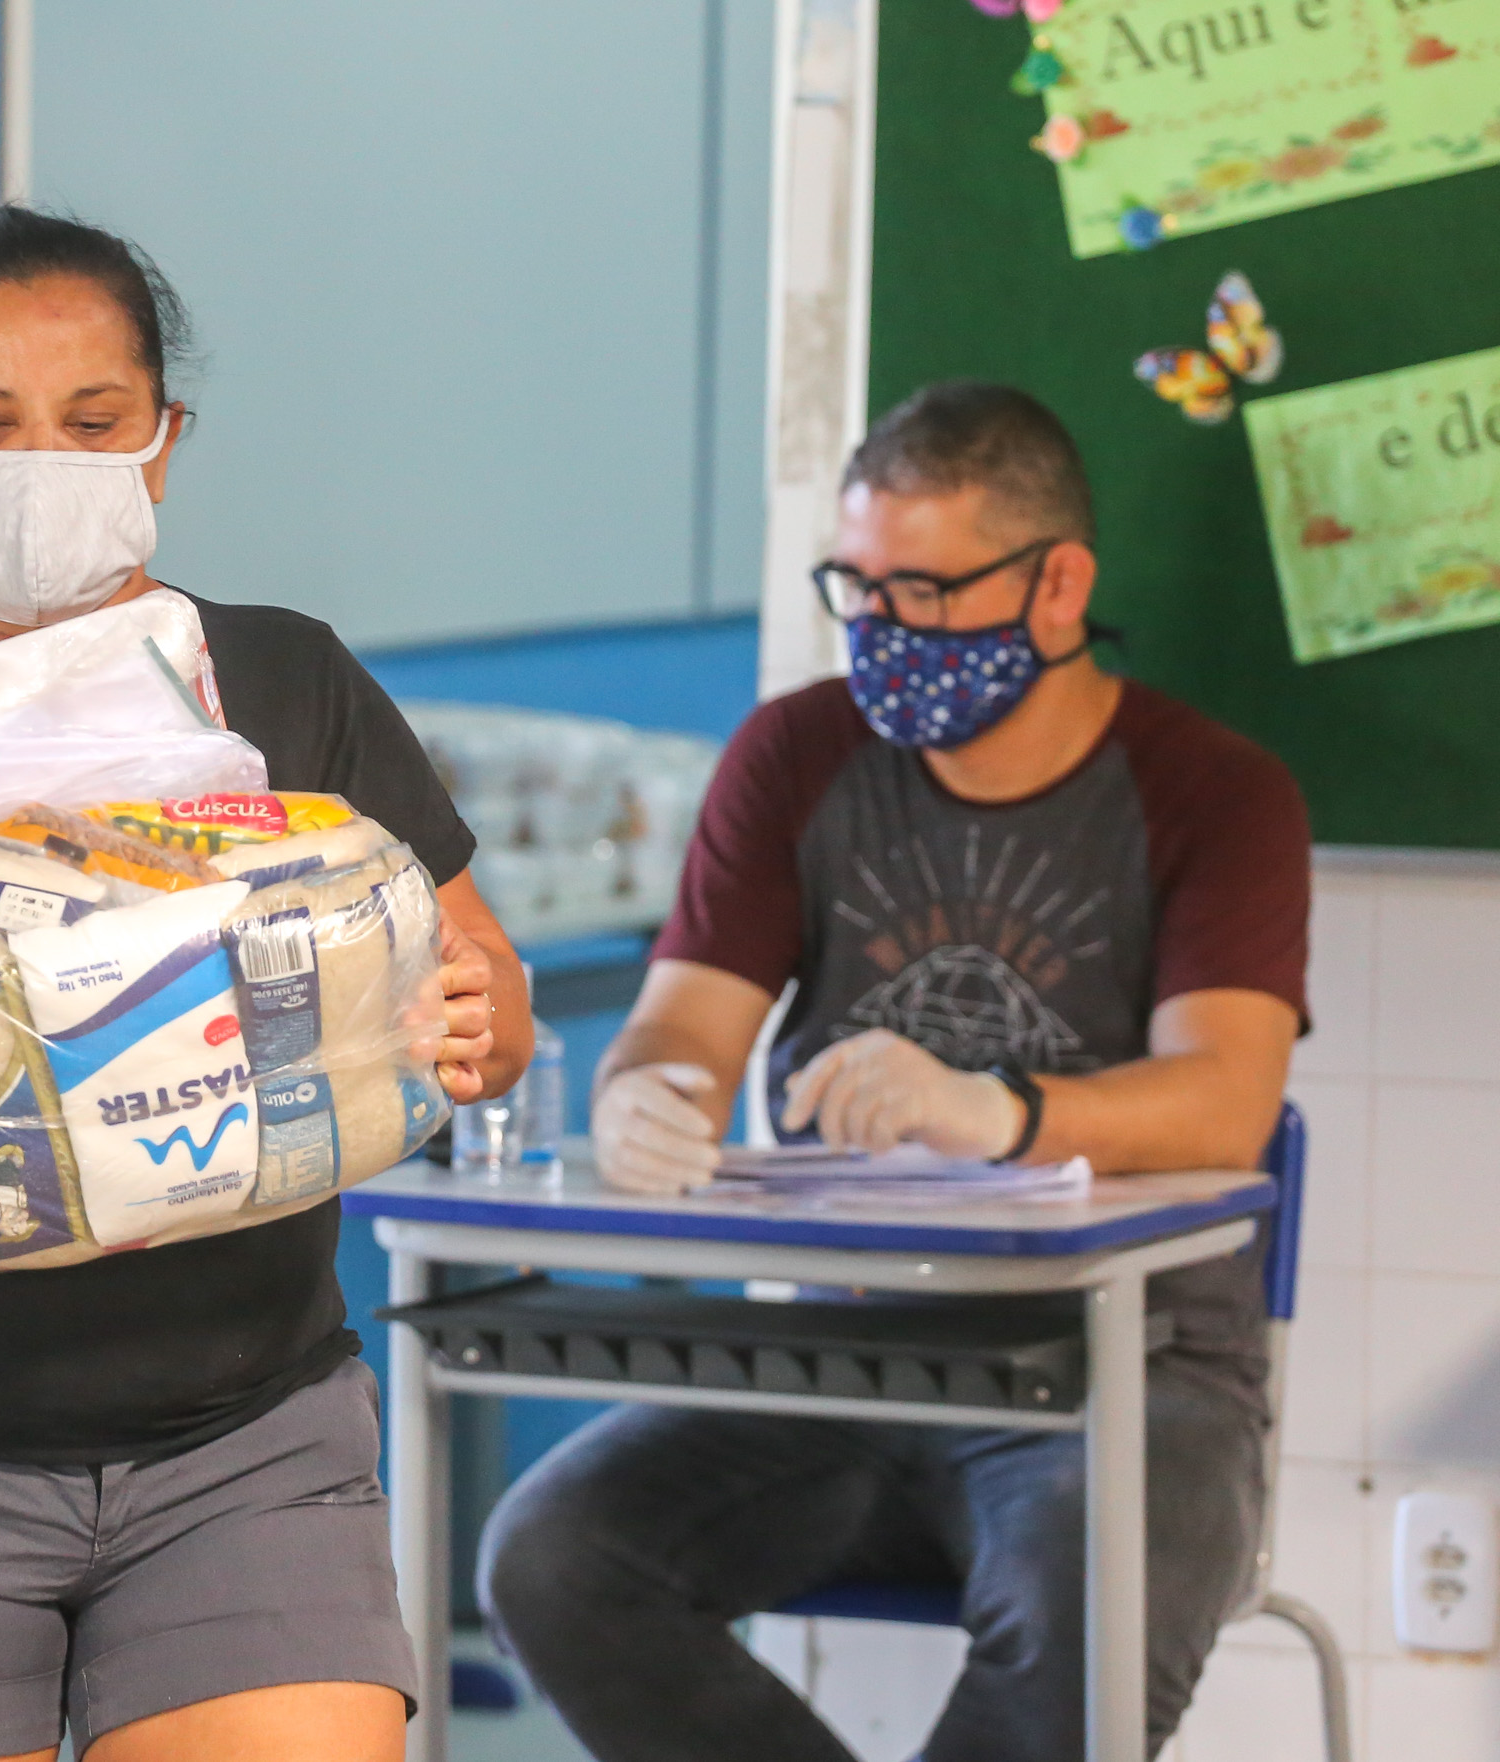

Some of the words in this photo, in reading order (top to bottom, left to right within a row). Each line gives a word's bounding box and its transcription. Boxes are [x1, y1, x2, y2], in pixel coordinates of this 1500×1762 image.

[172, 799, 272, 818] Cuscuz
[98, 971, 123, 983] Peso
[58, 980, 76, 992] 1kg
[200, 1169, 240, 1185] Refinado
[222, 1180, 242, 1193] Sal
[167, 1186, 219, 1206] Marinho
